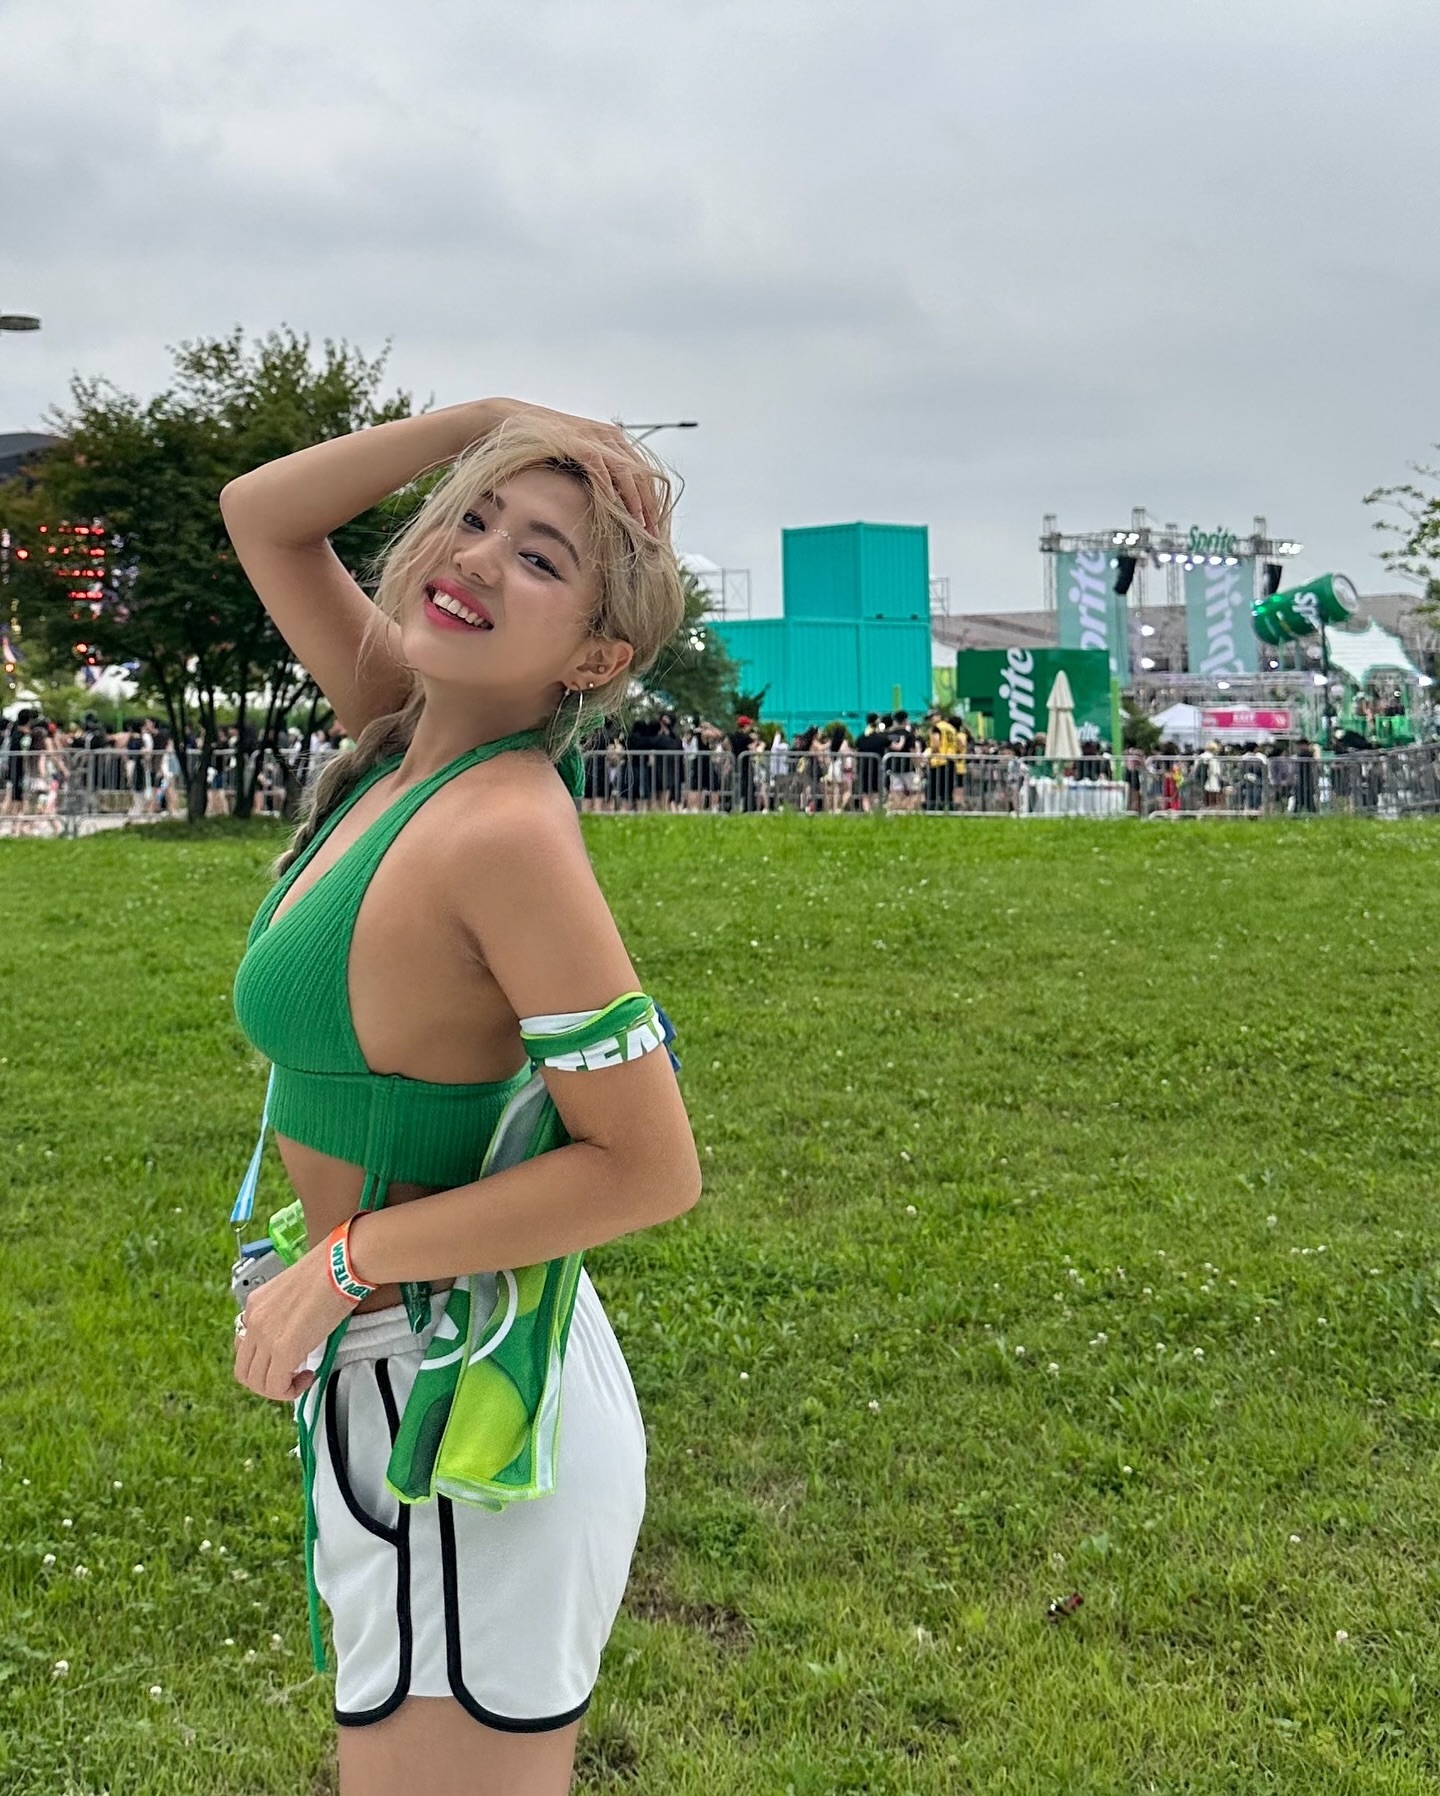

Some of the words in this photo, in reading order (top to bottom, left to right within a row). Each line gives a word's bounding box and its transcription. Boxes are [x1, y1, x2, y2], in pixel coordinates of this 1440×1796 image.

[1188, 525, 1236, 553] Sprite
[1068, 551, 1107, 650] prite
[999, 648, 1035, 745] prite
[332, 1242, 349, 1285] TEAM
